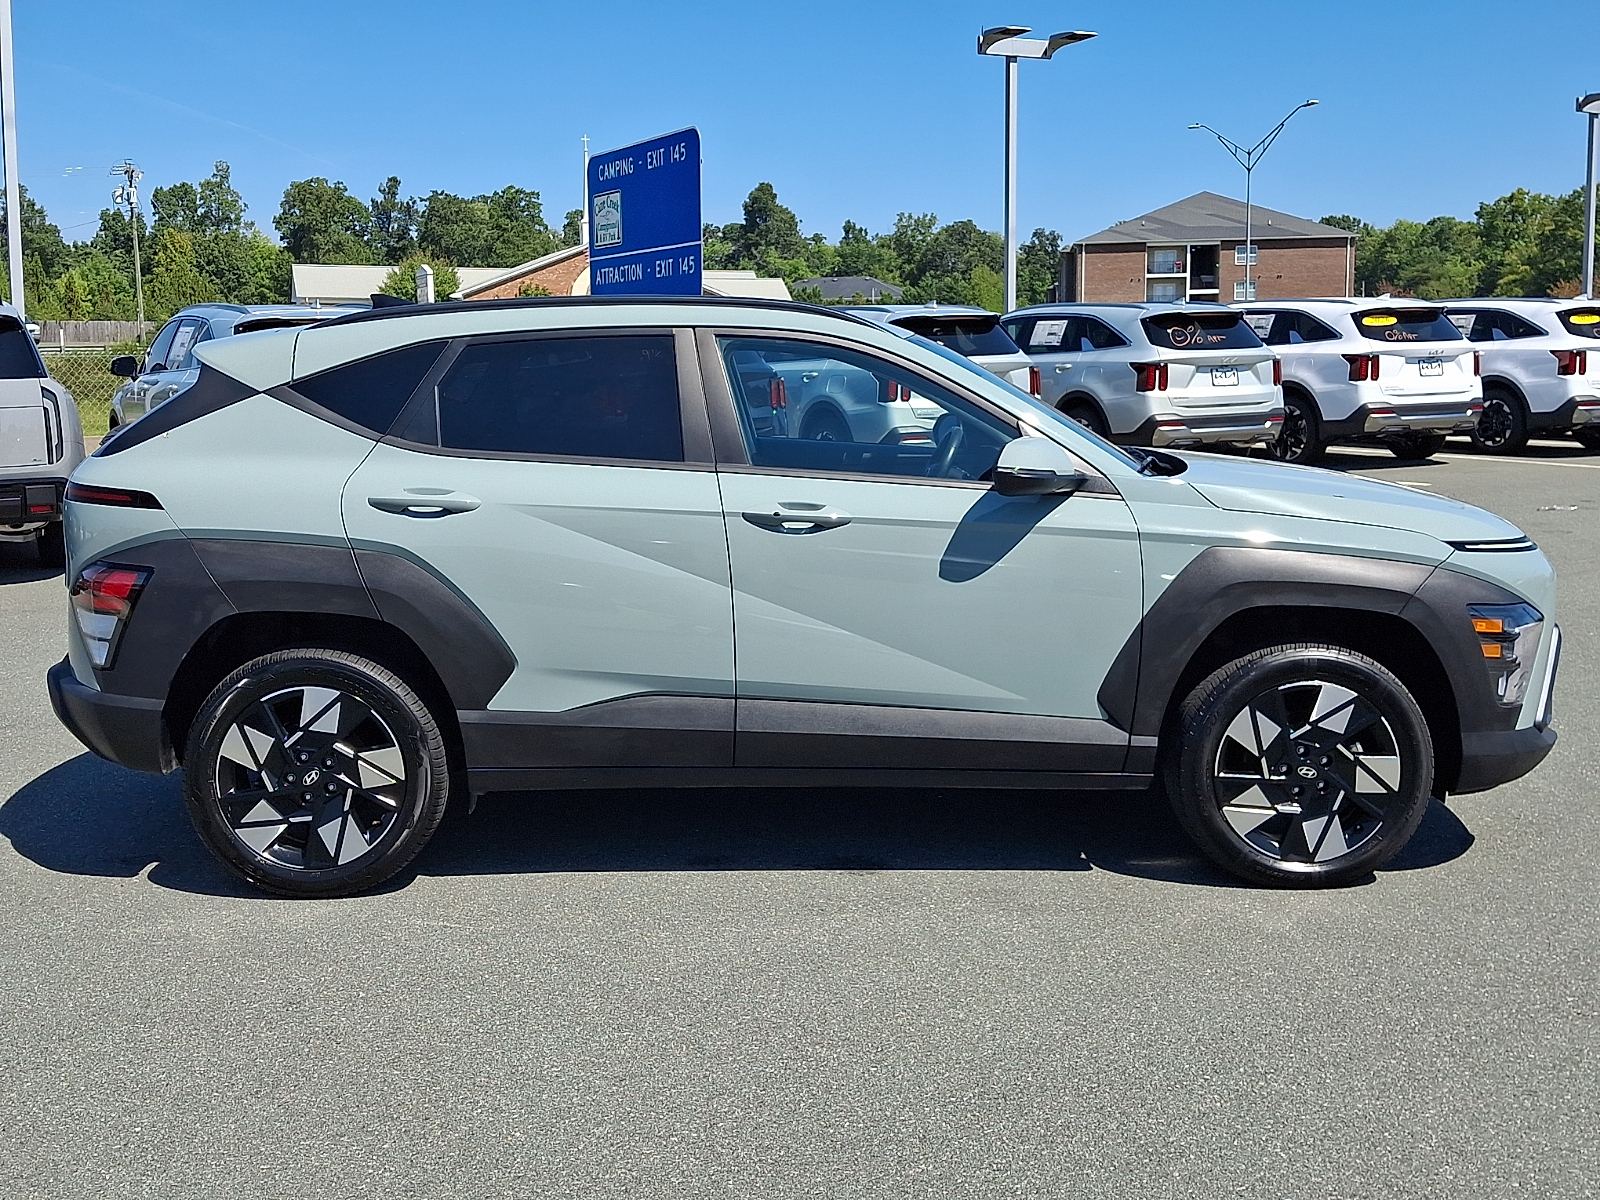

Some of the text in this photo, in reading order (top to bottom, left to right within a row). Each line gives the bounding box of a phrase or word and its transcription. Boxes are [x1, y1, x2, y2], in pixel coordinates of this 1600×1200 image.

[598, 157, 634, 181] CAMPING
[647, 148, 665, 170] EXIT
[670, 142, 686, 164] 145
[595, 263, 643, 286] ATTRACTION
[655, 258, 674, 279] EXIT
[678, 255, 695, 275] 145
